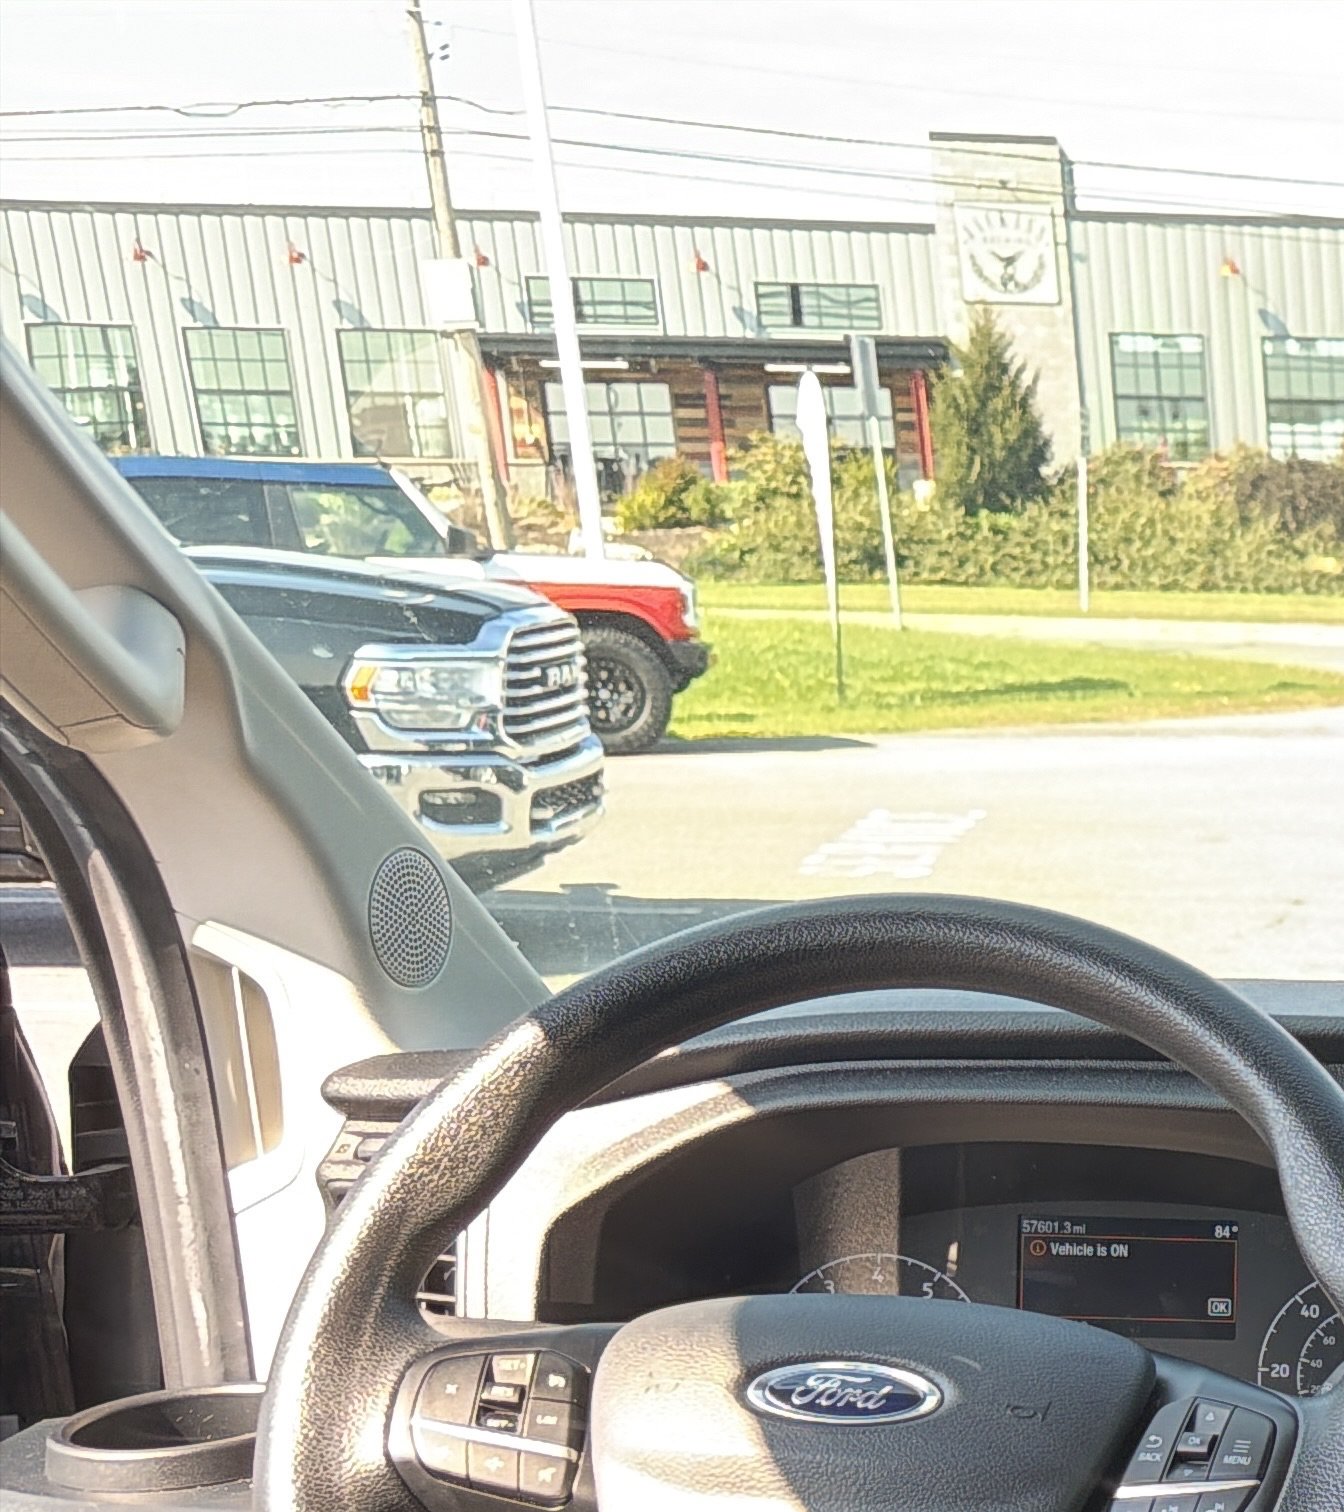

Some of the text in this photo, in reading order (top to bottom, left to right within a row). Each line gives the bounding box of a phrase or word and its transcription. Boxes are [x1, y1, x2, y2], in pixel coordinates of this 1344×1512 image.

[1021, 1219, 1072, 1235] 57601.3
[1214, 1224, 1239, 1239] 84°
[1050, 1242, 1129, 1258] Vehicle is ON
[922, 1282, 934, 1300] 5
[1211, 1302, 1228, 1314] OK
[1300, 1304, 1320, 1319] 40
[1322, 1336, 1336, 1346] 60
[1270, 1363, 1290, 1378] 20
[787, 1373, 894, 1410] Ford
[1137, 1452, 1163, 1463] BACK
[1222, 1454, 1252, 1466] MENU
